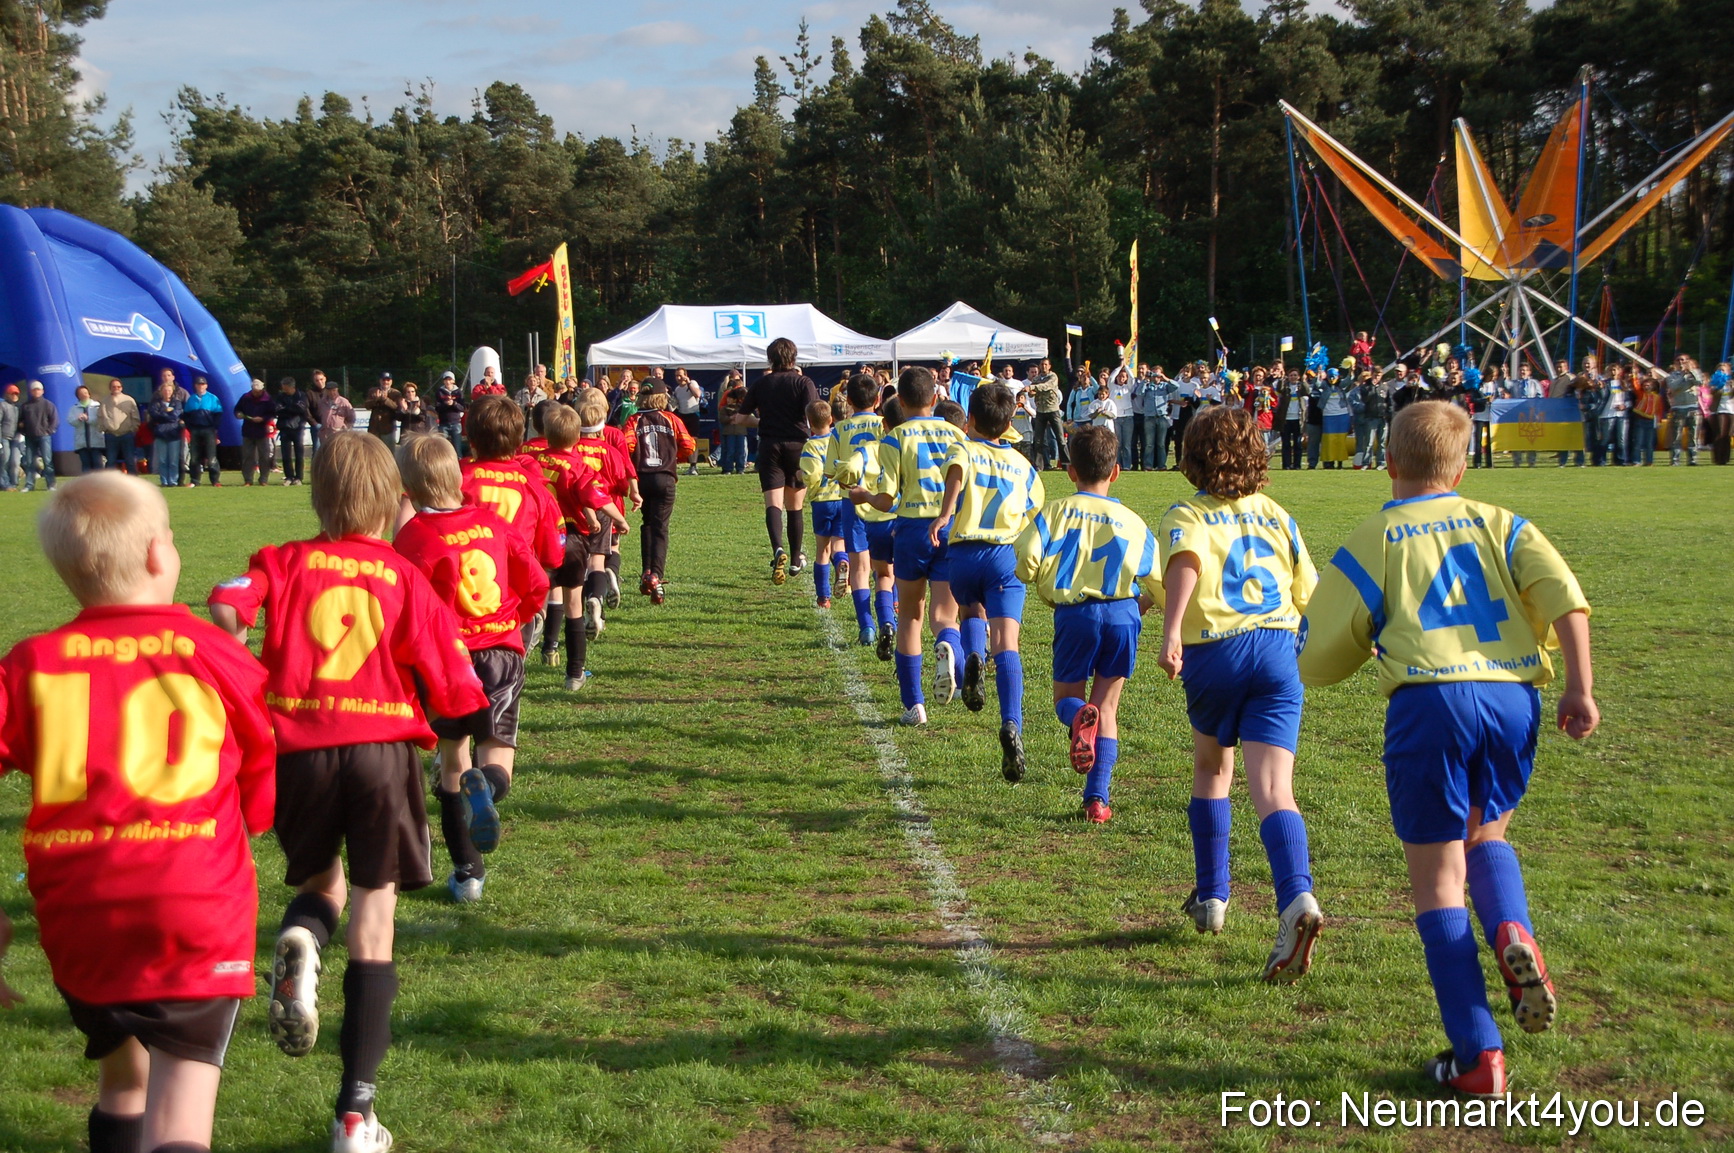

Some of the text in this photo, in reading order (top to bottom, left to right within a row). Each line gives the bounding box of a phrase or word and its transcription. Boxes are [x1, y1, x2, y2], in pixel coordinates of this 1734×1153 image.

[139, 322, 154, 341] 1
[474, 467, 527, 485] Angola
[917, 442, 947, 493] 5
[481, 485, 522, 524] 7
[975, 472, 1014, 529] 7
[1063, 505, 1124, 530] Ukraine
[1203, 510, 1281, 531] Ukraine
[1386, 515, 1485, 543] Ukraine
[440, 524, 494, 546] ngola
[309, 550, 397, 586] Angola
[1046, 528, 1130, 597] 11
[1222, 534, 1282, 615] 6
[457, 549, 503, 618] 8
[1417, 542, 1509, 643] 4
[65, 630, 195, 662] Angola
[310, 586, 385, 681] 9
[1201, 626, 1249, 639] Bayern
[1407, 653, 1543, 678] Bayern 1 Mini-W
[266, 691, 415, 718] Bayern 1 Mini-WM
[31, 672, 227, 804] 10
[104, 825, 115, 840] 1
